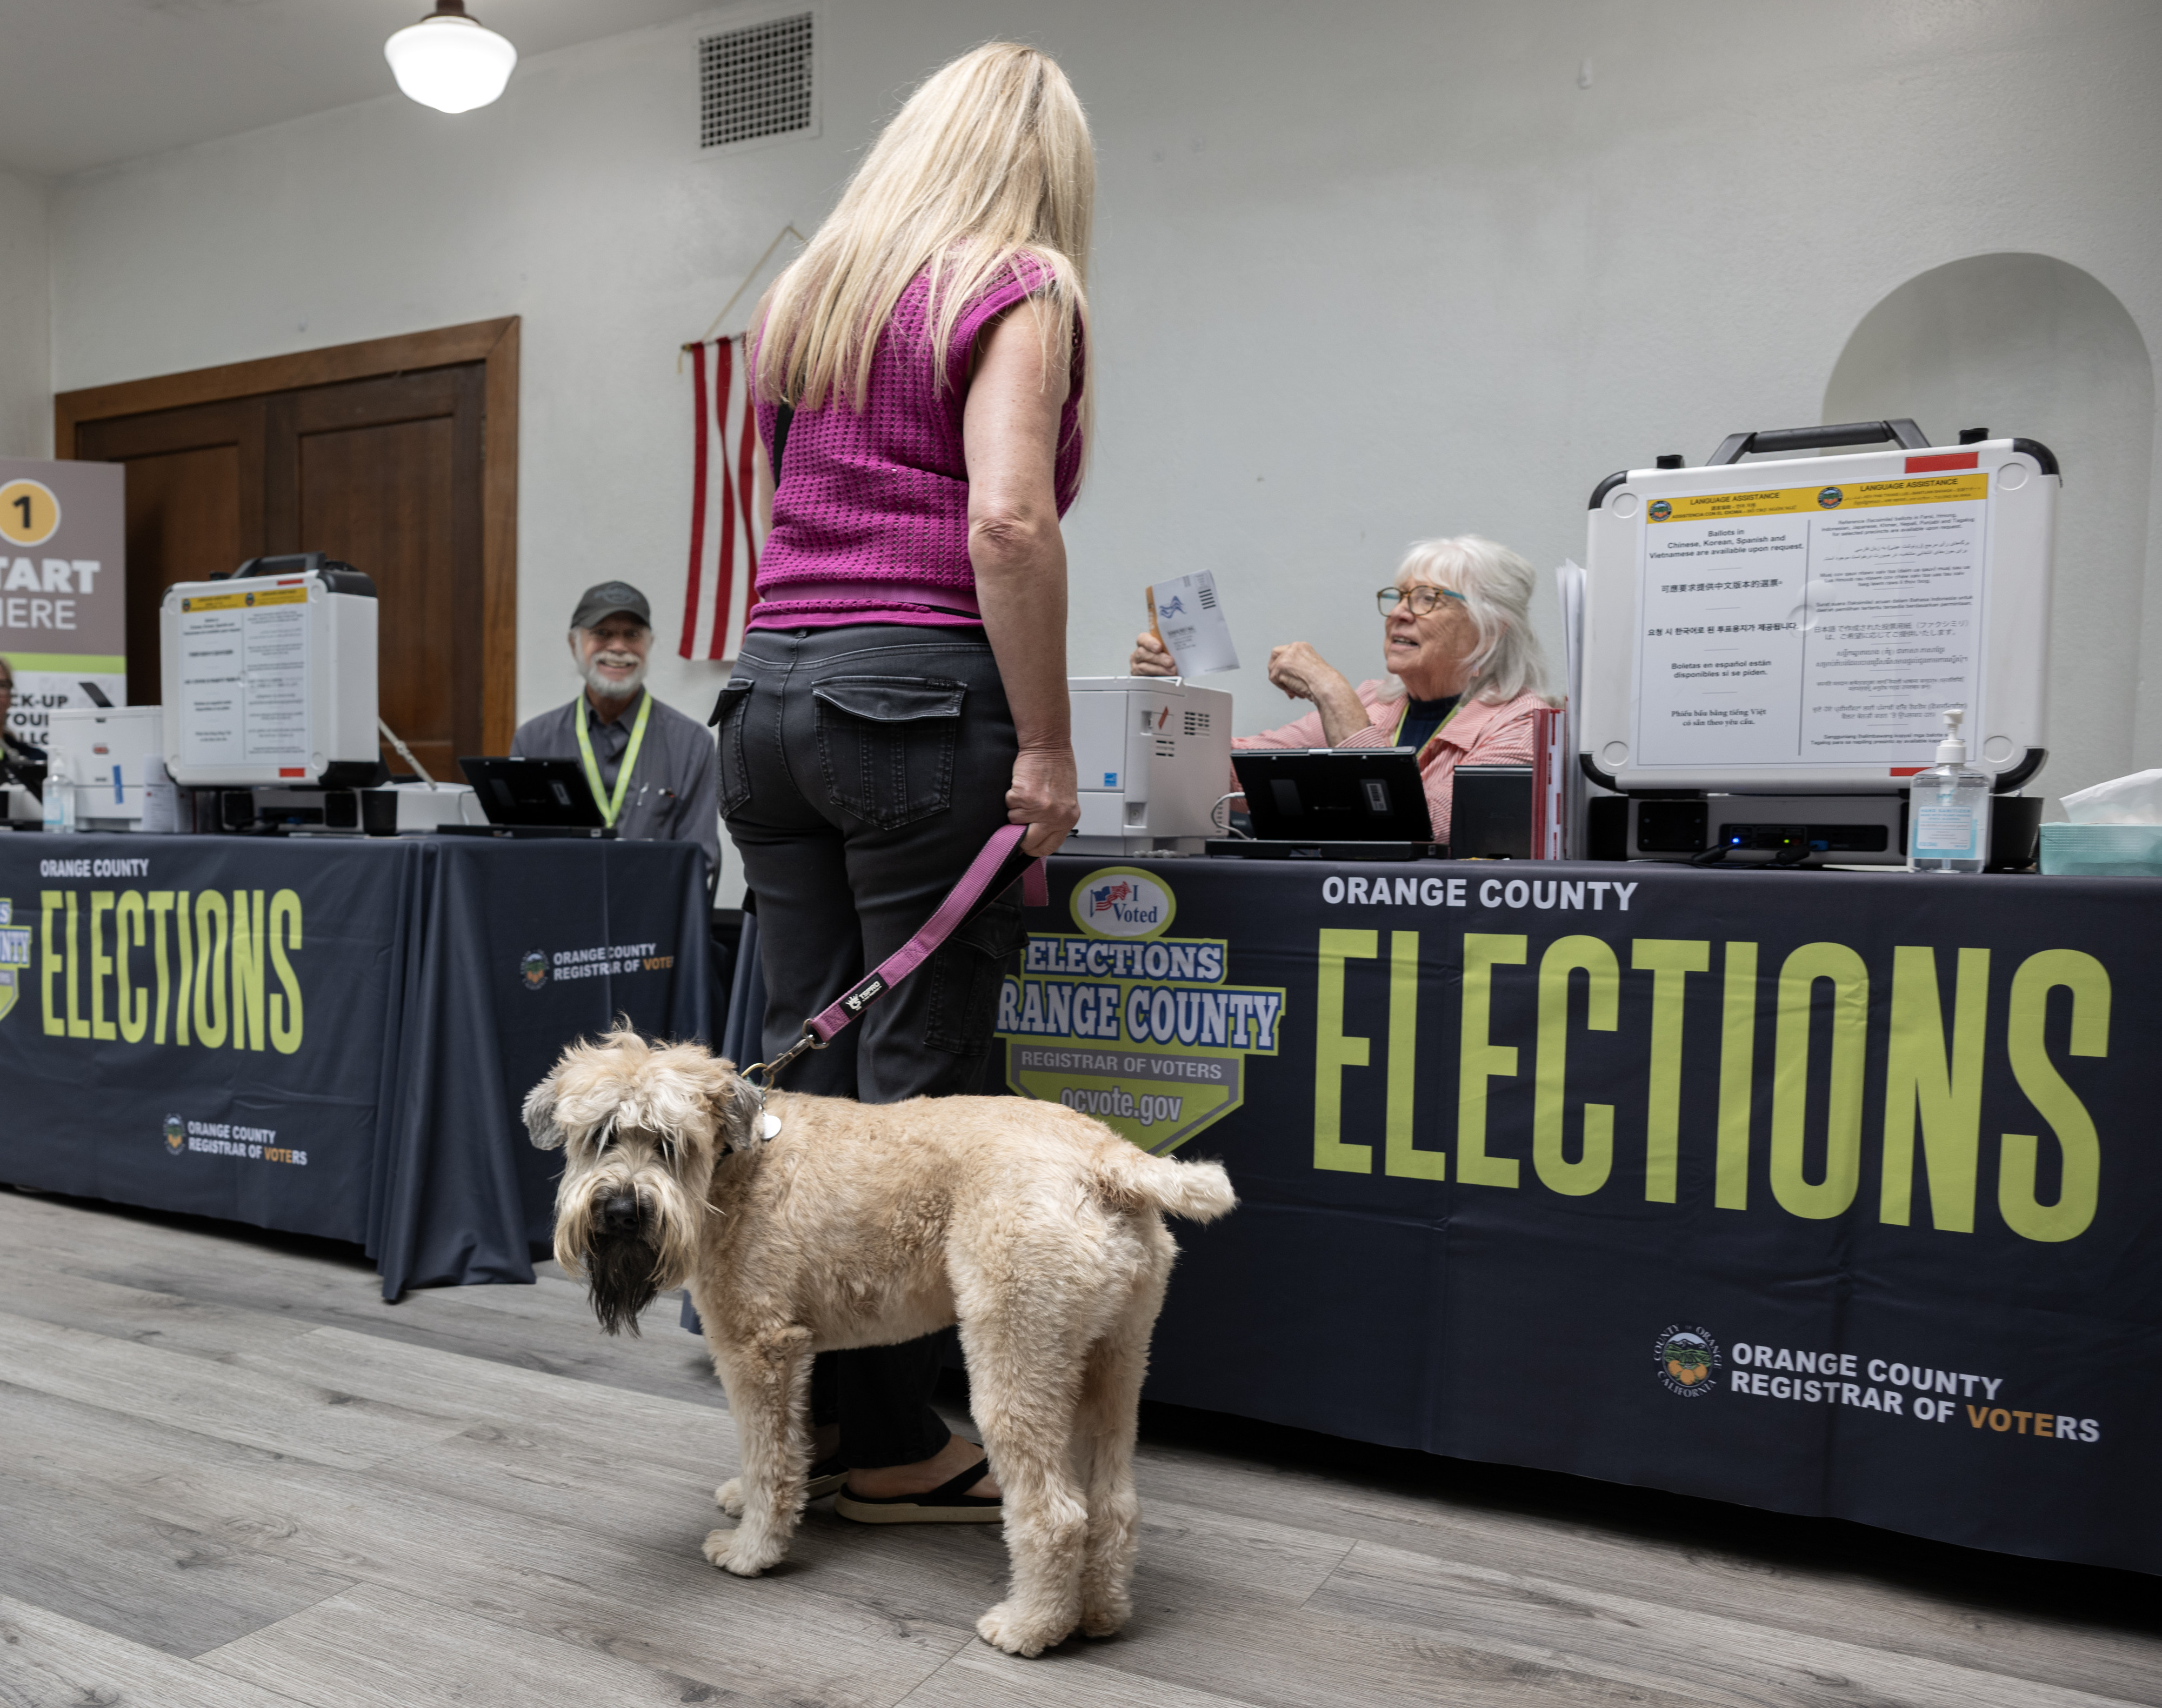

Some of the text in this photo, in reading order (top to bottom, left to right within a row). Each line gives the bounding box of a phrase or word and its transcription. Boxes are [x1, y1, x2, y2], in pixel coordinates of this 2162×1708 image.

[1690, 492, 1780, 505] LANGUAGE ASSISTANCE
[1860, 478, 1958, 492] LANGUAGE ASSISTANCE
[13, 496, 31, 529] 1
[1710, 547, 1746, 555] available
[1736, 537, 1769, 545] Spanish
[0, 556, 101, 594] ART
[0, 597, 76, 630] ERE
[41, 859, 149, 877] ORANGE COUNTY
[1132, 884, 1139, 902] I
[1322, 877, 1638, 910] ORANGE COUNTY
[1113, 903, 1158, 923] Voted
[553, 943, 656, 965] ORANGE COUNTY
[624, 959, 640, 973] OF
[643, 956, 674, 971] VOTE
[1026, 940, 1222, 979] ELECTIONS
[41, 889, 303, 1054] ELECTIONS
[998, 983, 1278, 1046] RANGE COUNTY
[1022, 1051, 1222, 1079] REGISTRAR OF VOTERS
[1313, 928, 2112, 1242] ELECTIONS
[1061, 1086, 1182, 1125] ocvote.gov
[188, 1120, 230, 1138] ORANGE
[232, 1126, 276, 1144] COUNTY
[189, 1137, 308, 1165] REGISTRAR OF VOTERS
[1653, 1325, 1679, 1361] COUNTY
[1696, 1327, 1723, 1369] ORANGE
[1657, 1371, 1717, 1397] CALIFORNIA
[1732, 1343, 2003, 1400] ORANGE COUNTY
[1731, 1370, 2100, 1443] REGISTRAR OF VOTERS
